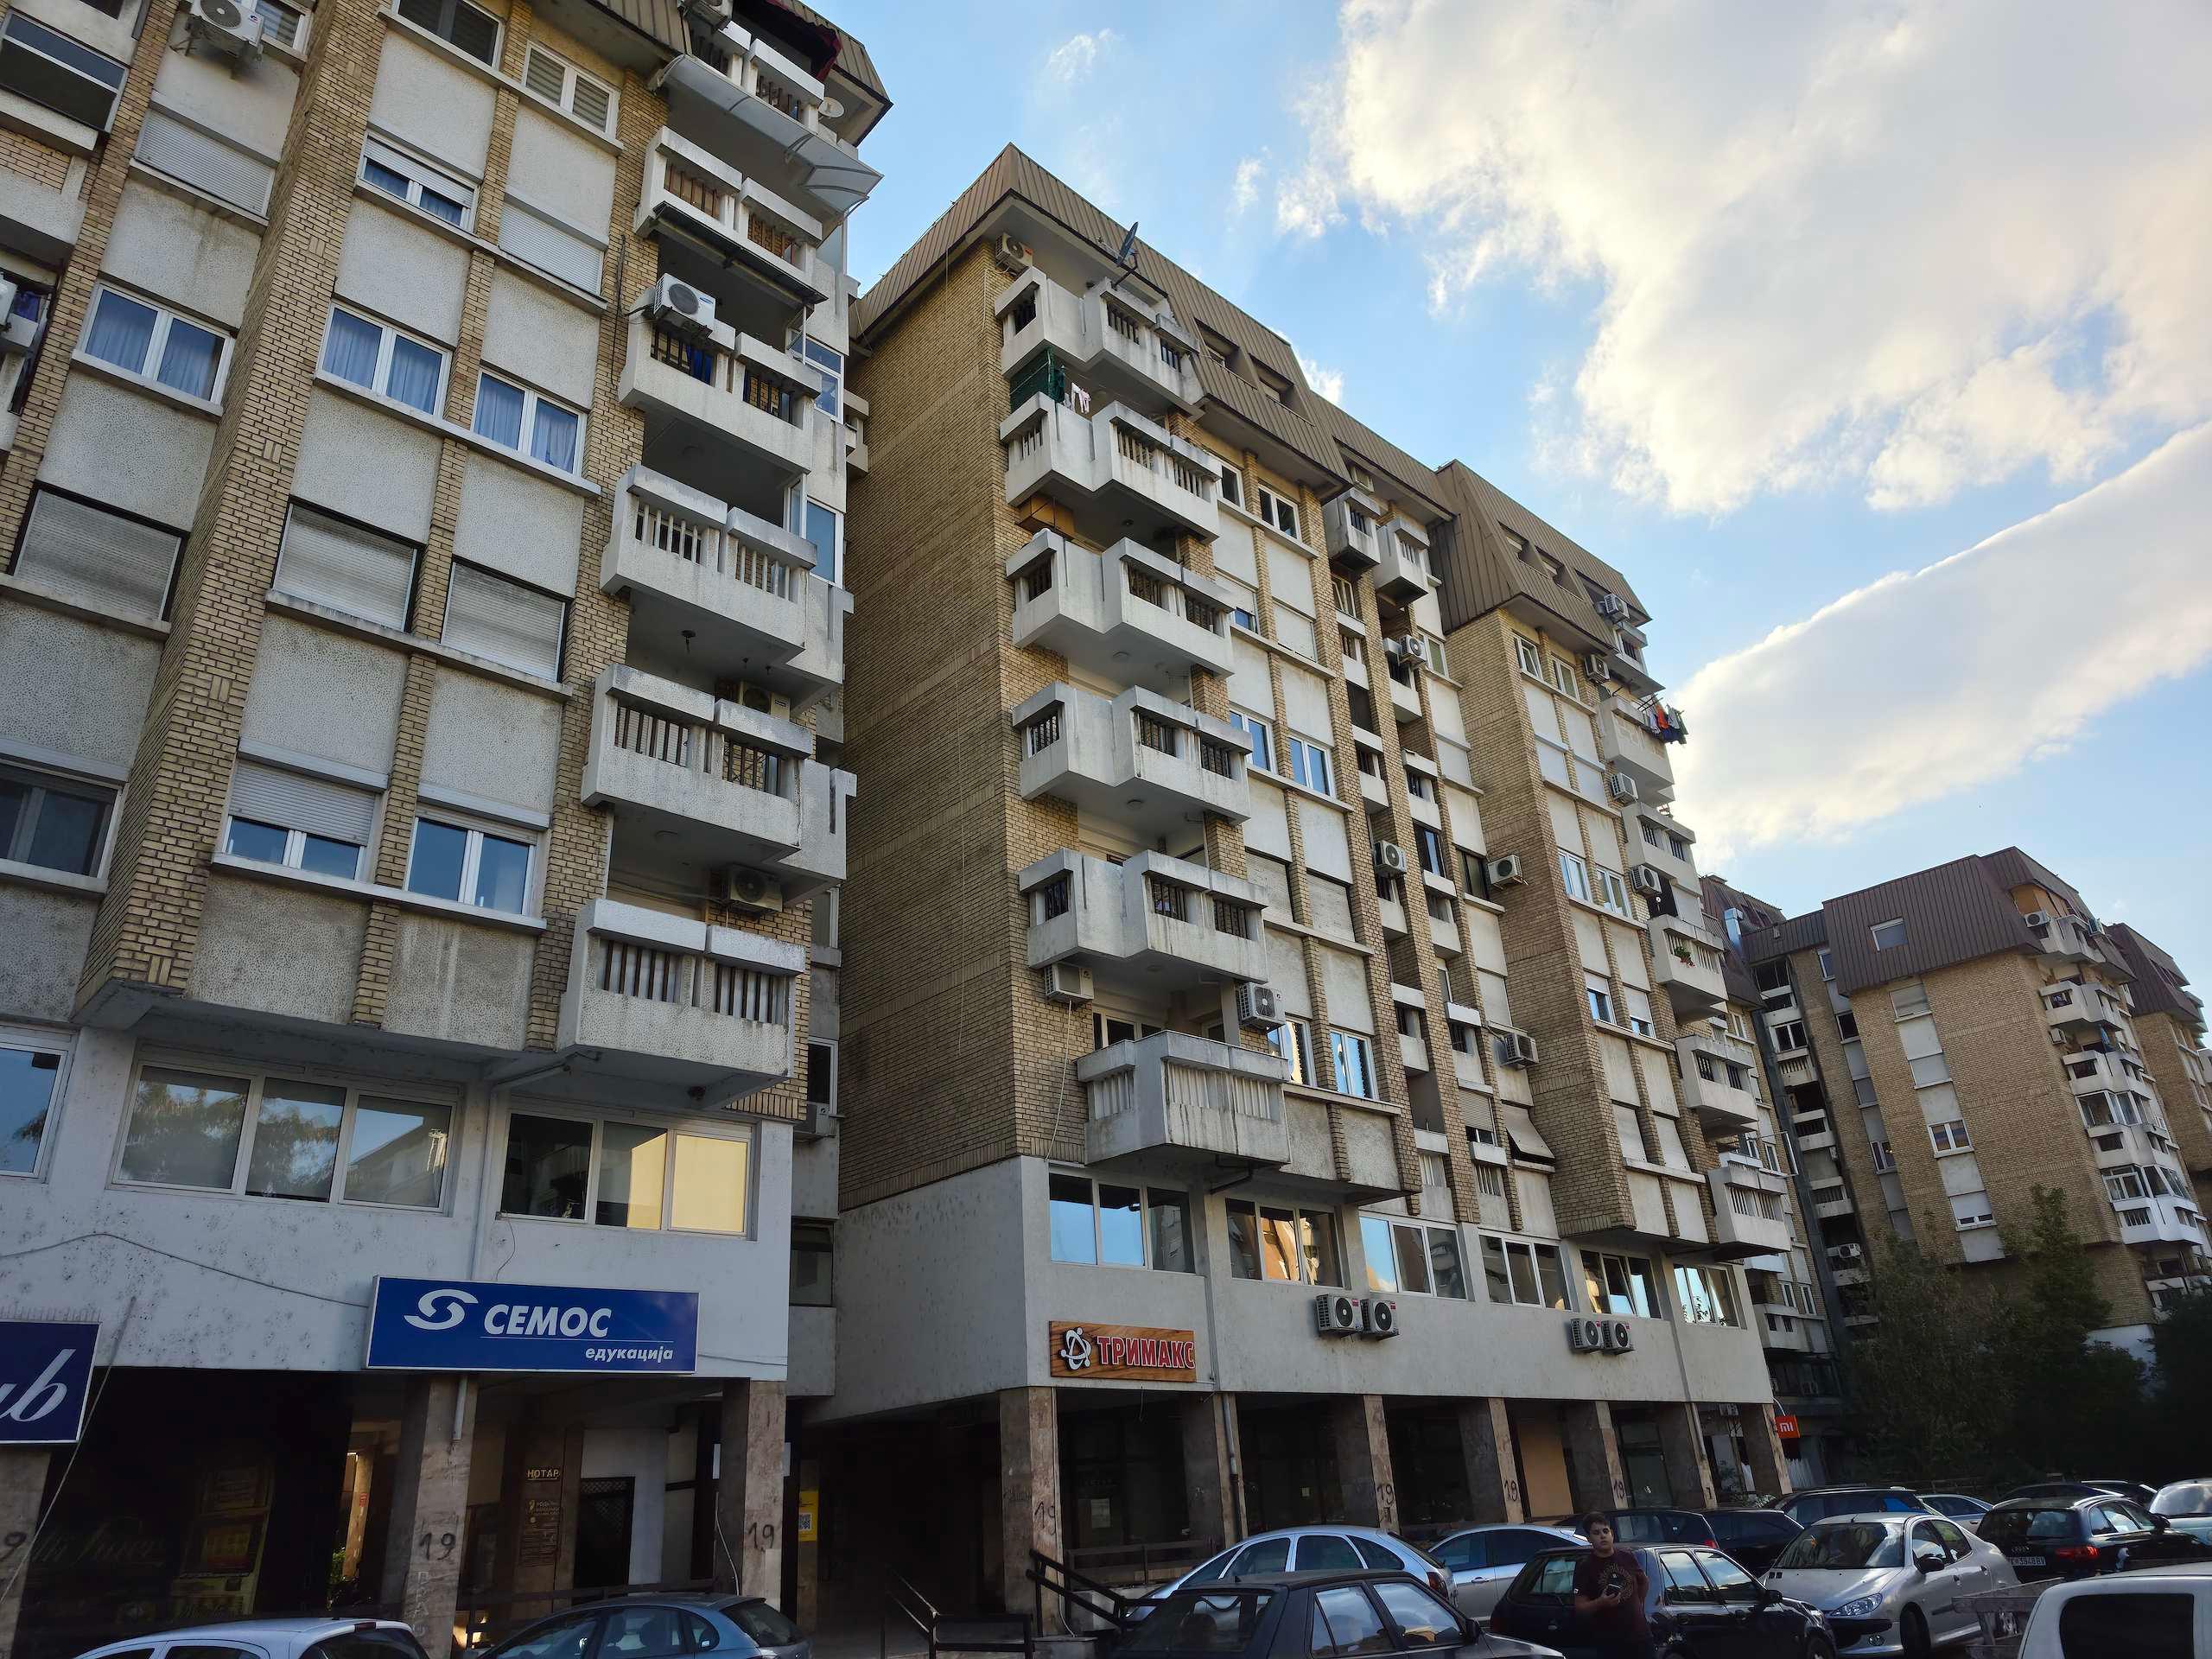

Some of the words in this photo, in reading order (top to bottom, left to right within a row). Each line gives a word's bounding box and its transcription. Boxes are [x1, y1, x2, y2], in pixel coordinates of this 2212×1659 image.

[484, 1304, 612, 1338] СЕМОС
[585, 1346, 673, 1363] едукација
[1096, 1336, 1196, 1369] ТРИМАКС
[419, 1532, 456, 1560] 19
[748, 1522, 775, 1549] 19
